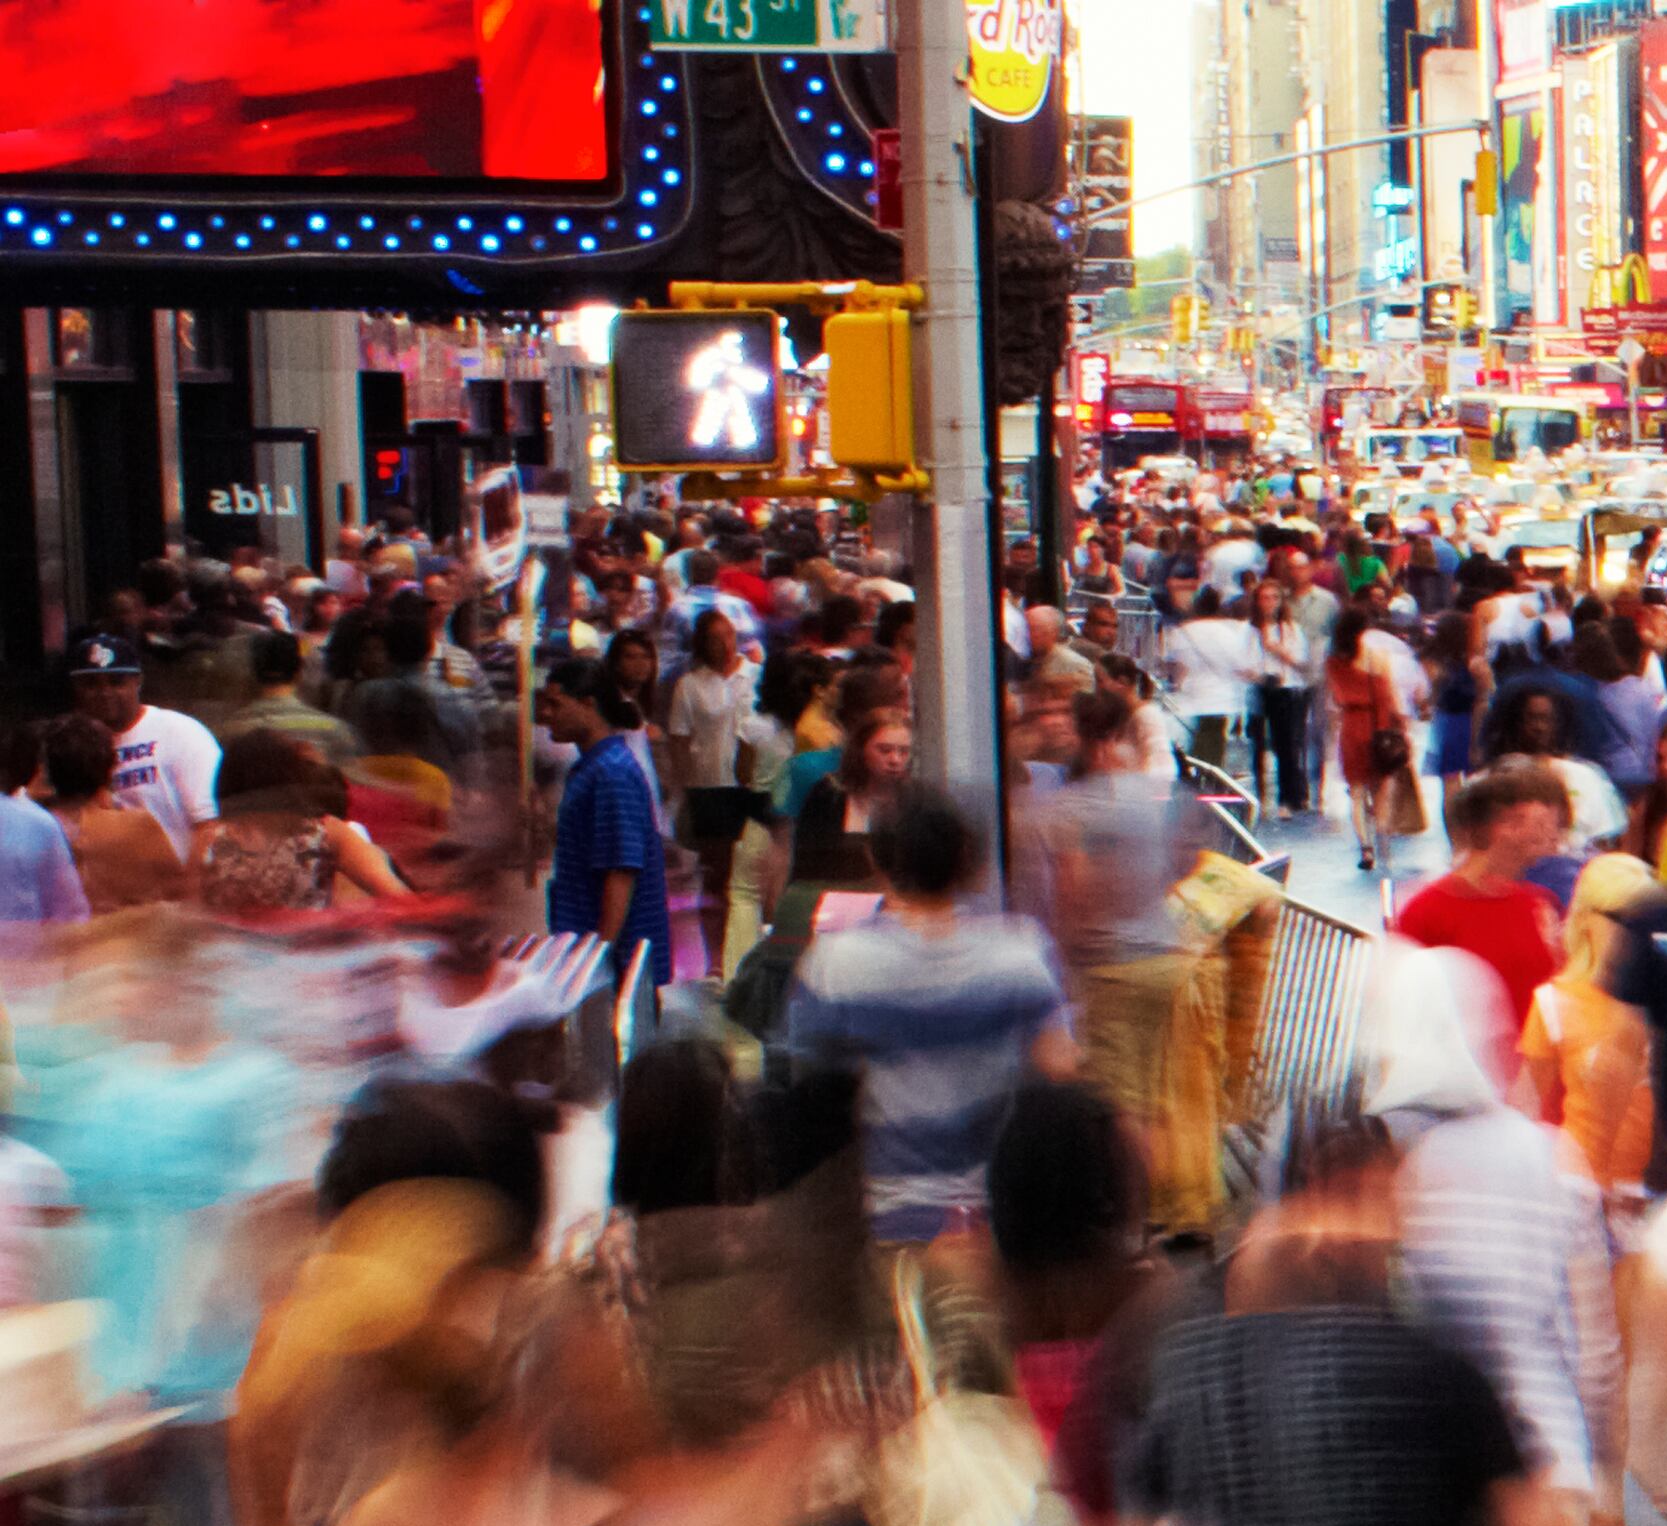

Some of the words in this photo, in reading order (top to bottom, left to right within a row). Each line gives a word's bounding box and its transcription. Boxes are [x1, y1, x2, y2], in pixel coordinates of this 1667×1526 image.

[660, 0, 692, 39] W
[704, 0, 758, 40] 43
[986, 67, 1034, 89] CAFE
[1574, 79, 1595, 271] PALACE
